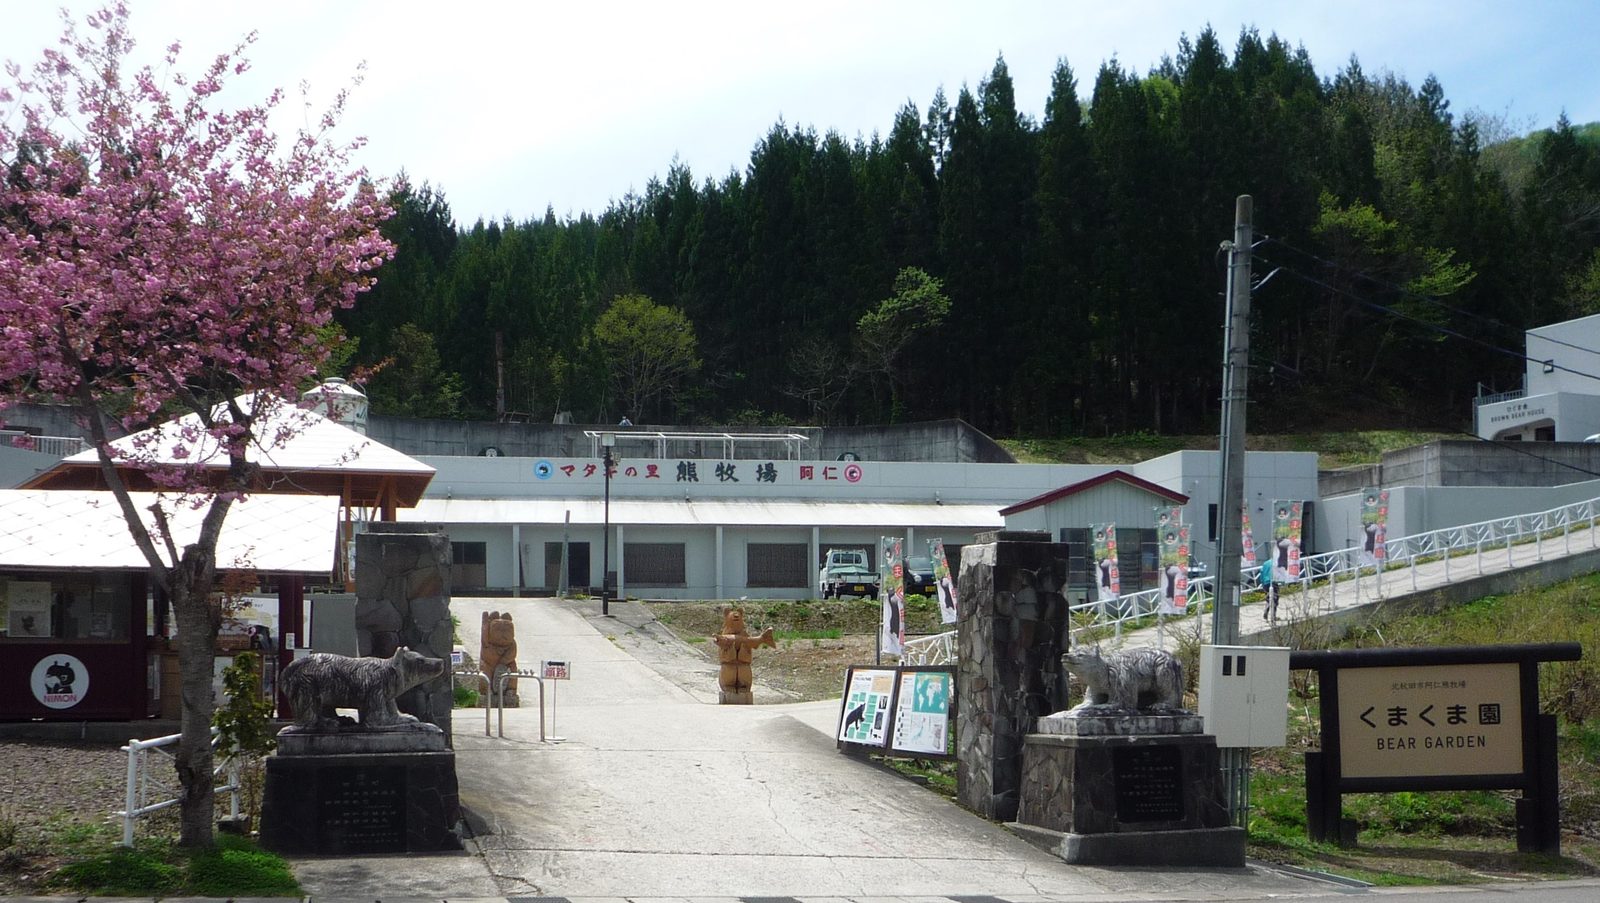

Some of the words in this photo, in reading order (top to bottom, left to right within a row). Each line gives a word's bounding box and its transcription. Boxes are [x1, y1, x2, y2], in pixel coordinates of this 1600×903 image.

[1490, 414, 1510, 423] BROWN
[1511, 411, 1526, 420] BEAR
[1527, 408, 1545, 417] HOUSE
[675, 460, 779, 483] 熊牧場
[799, 465, 838, 481] 阿仁
[544, 666, 567, 678] 順路
[42, 693, 78, 704] NIMON
[1359, 702, 1501, 728] くまくま園
[1376, 736, 1417, 750] BEAR
[1424, 735, 1487, 749] GARDEN
